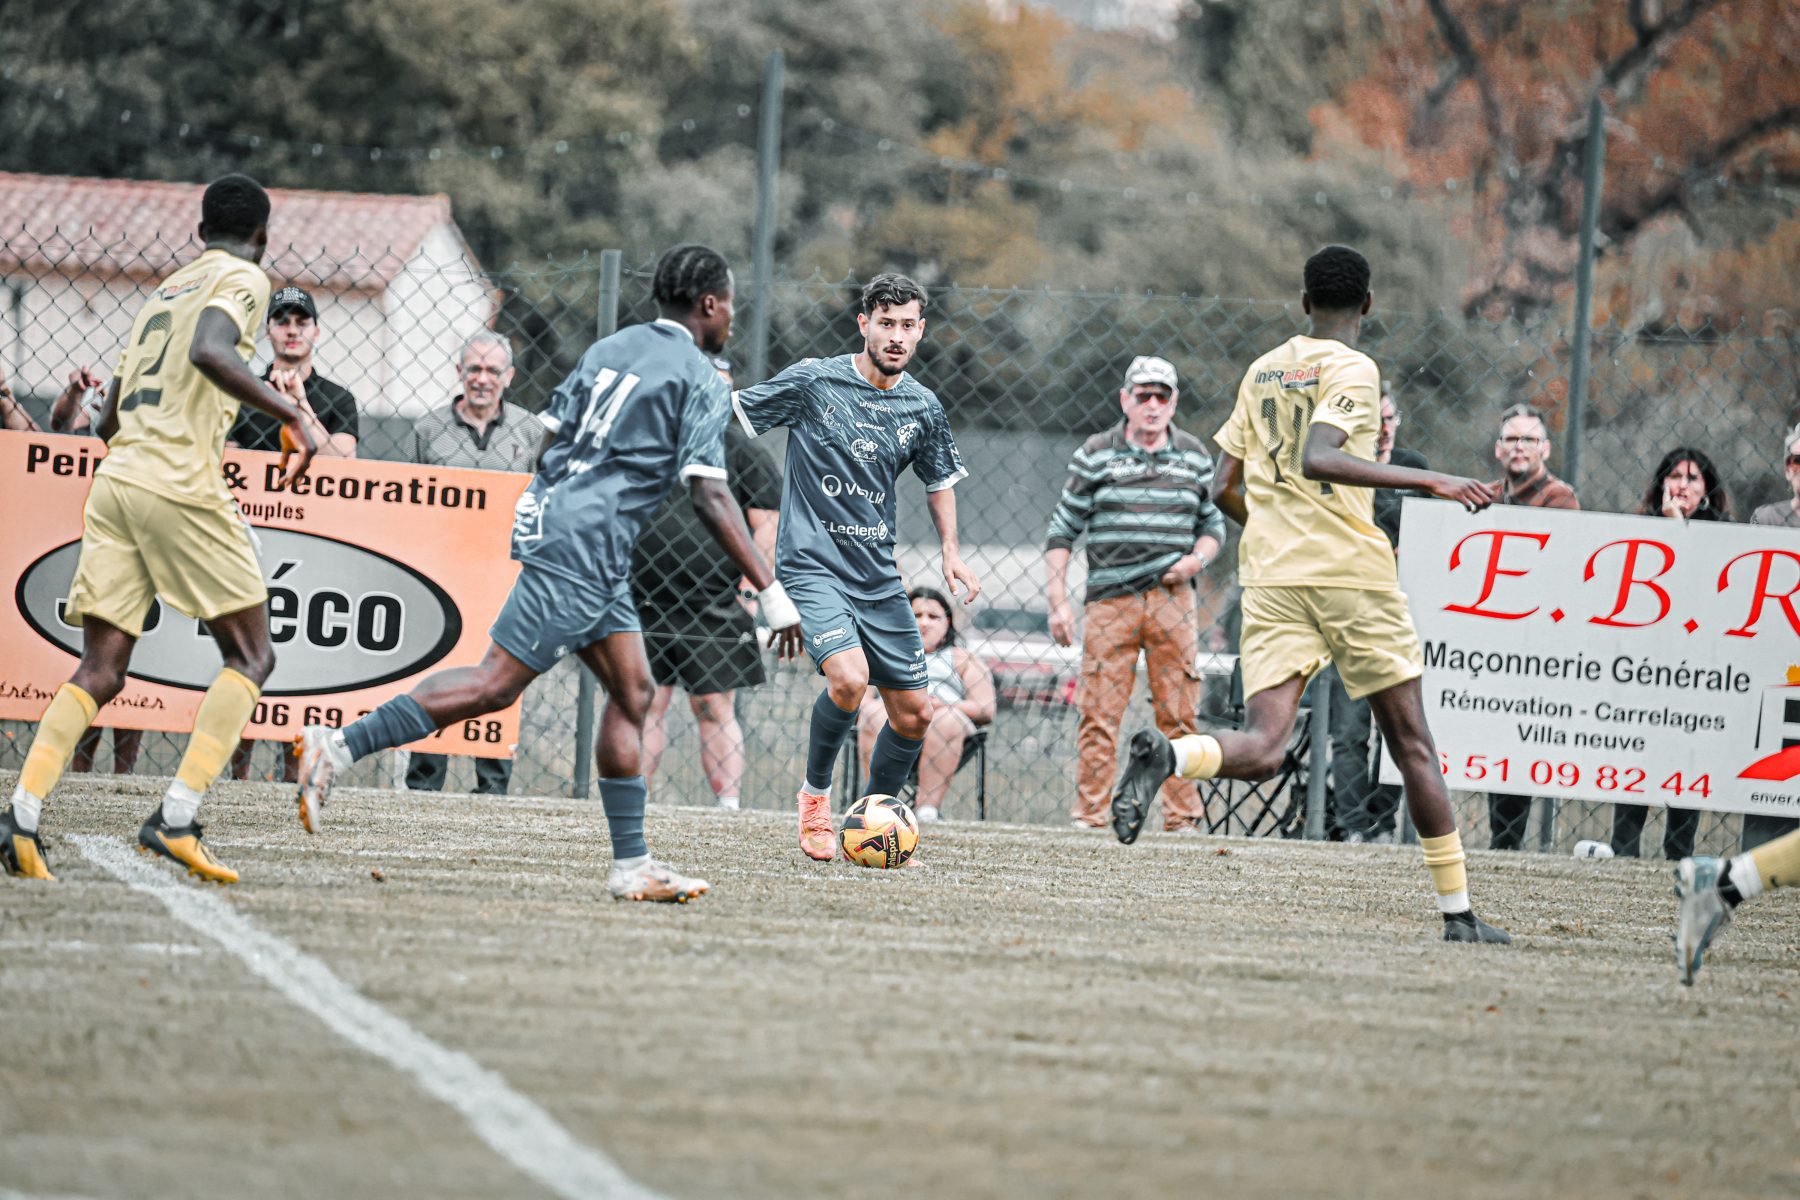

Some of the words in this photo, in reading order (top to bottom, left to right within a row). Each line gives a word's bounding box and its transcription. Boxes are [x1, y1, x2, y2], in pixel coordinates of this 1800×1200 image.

[119, 310, 175, 411] 2
[859, 401, 891, 413] uhlsport
[233, 498, 304, 521] ouples
[197, 562, 402, 653] éco
[1424, 640, 1601, 682] Maçonnerie
[1612, 655, 1750, 693] Générale
[251, 702, 290, 726] 06
[464, 719, 502, 743] 68
[1441, 688, 1572, 719] Rénovation
[1595, 702, 1725, 732] Carrelages
[1517, 723, 1566, 745] Villa
[1575, 732, 1645, 752] neuve
[1465, 754, 1508, 782] 51
[1530, 760, 1579, 787] 09
[1596, 765, 1646, 793] 82
[1661, 771, 1712, 798] 44
